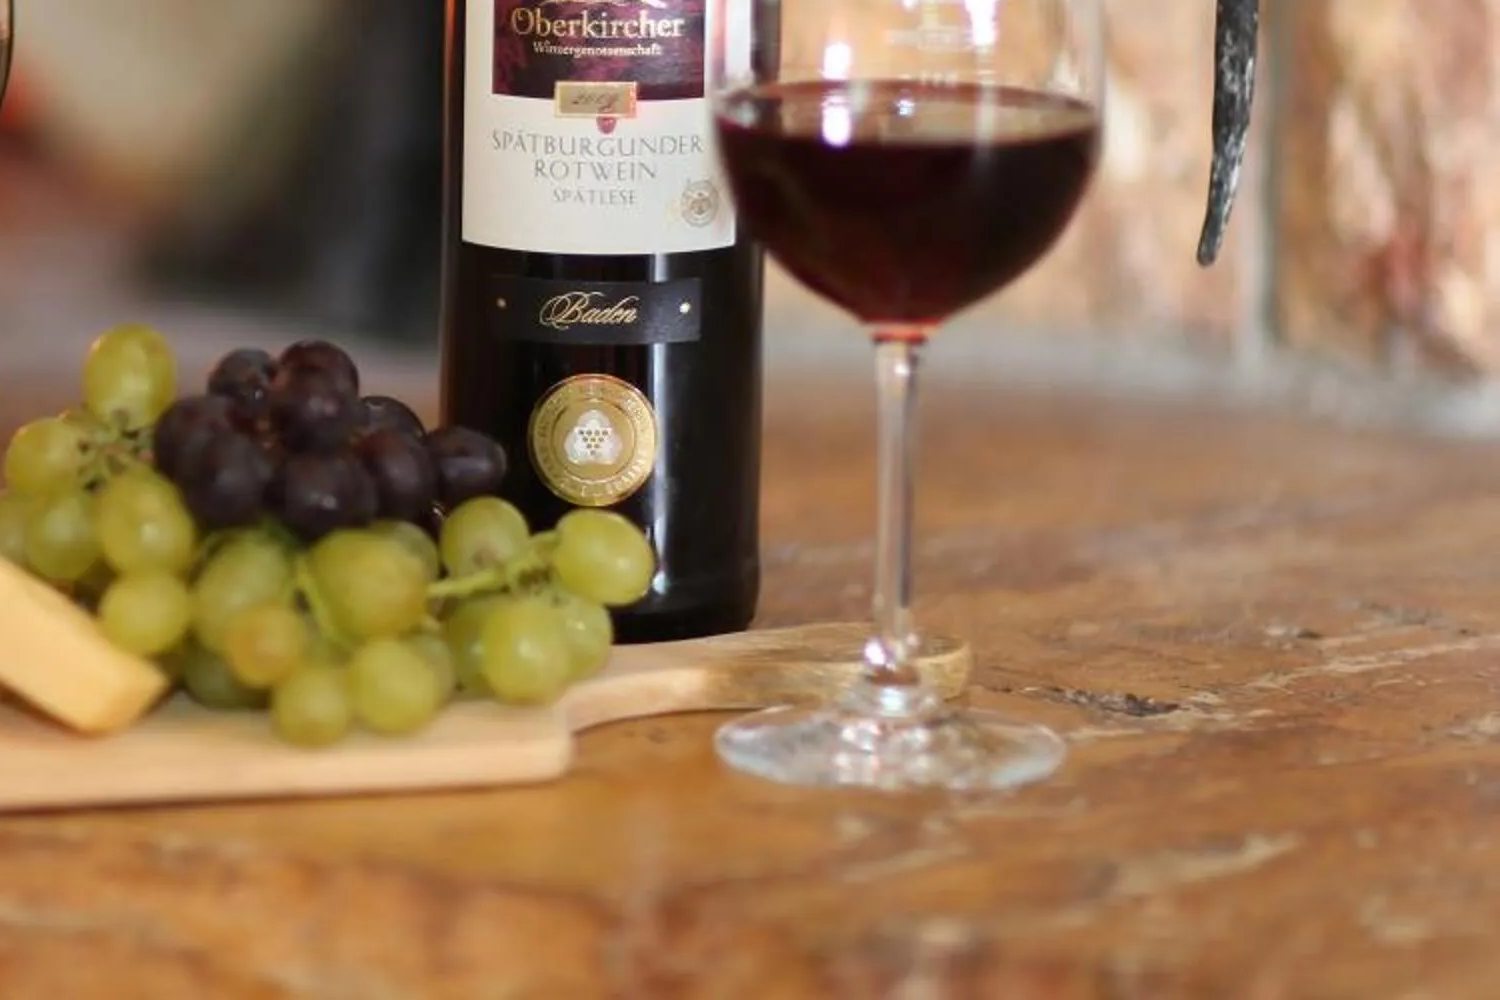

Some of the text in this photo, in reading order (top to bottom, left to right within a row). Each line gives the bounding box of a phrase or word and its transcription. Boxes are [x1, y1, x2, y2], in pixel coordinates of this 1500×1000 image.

[510, 6, 685, 39] Oberkircher
[491, 129, 704, 158] SPÄTBURGUNDER
[534, 158, 657, 181] ROTWEIN
[539, 291, 639, 330] Baden
